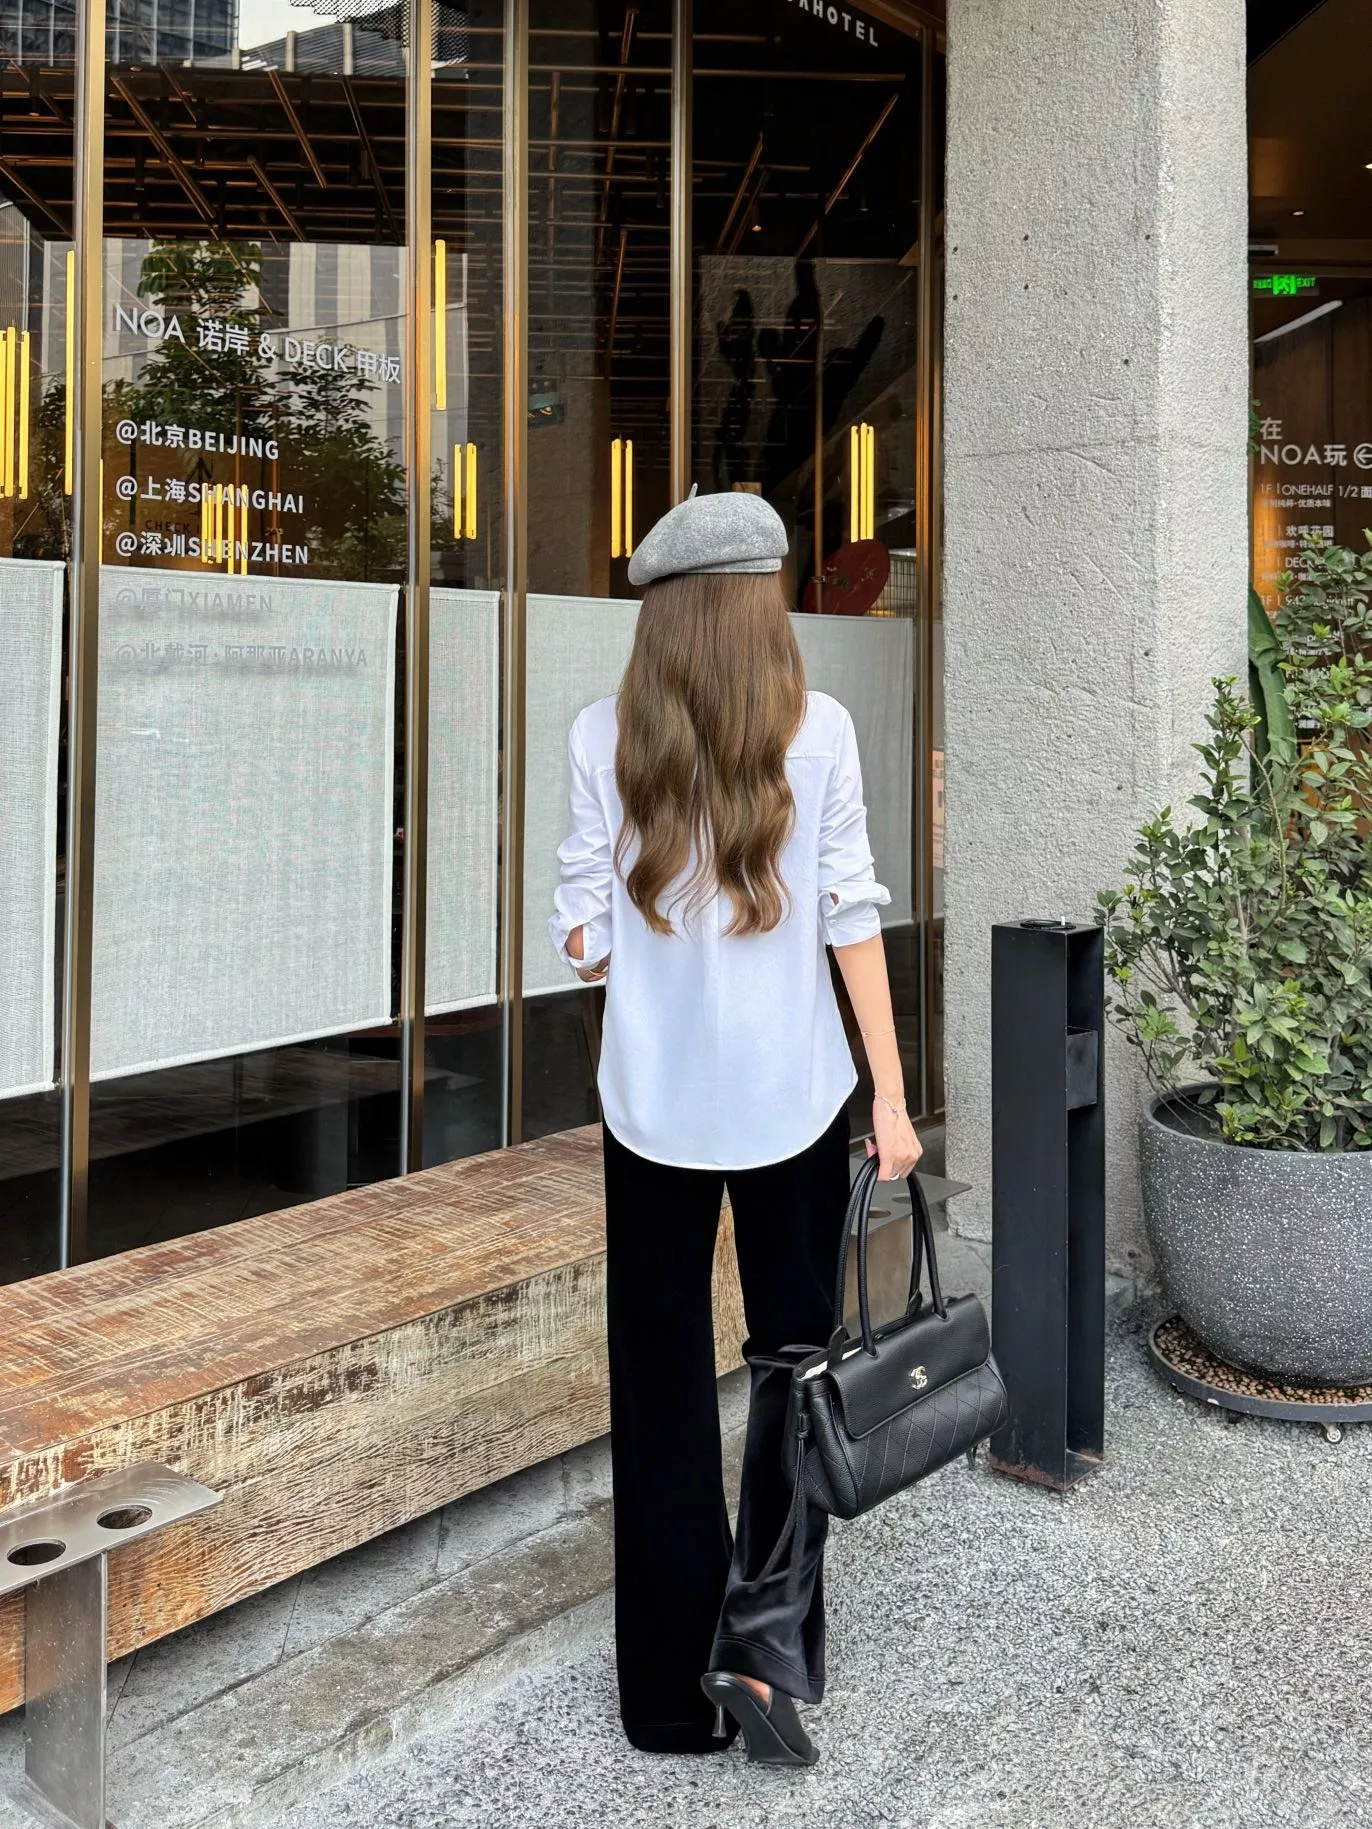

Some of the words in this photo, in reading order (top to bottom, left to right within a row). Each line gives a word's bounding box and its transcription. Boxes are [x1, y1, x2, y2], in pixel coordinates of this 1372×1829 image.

[1296, 277, 1316, 287] EXIT
[115, 303, 185, 343] NOA
[197, 319, 249, 355] 诺岸
[258, 332, 276, 360] &
[284, 337, 348, 372] DECK
[356, 350, 401, 384] 甲板
[115, 419, 279, 460] @北京BEIJING
[1259, 417, 1283, 440] 在
[145, 519, 191, 534] CHECK
